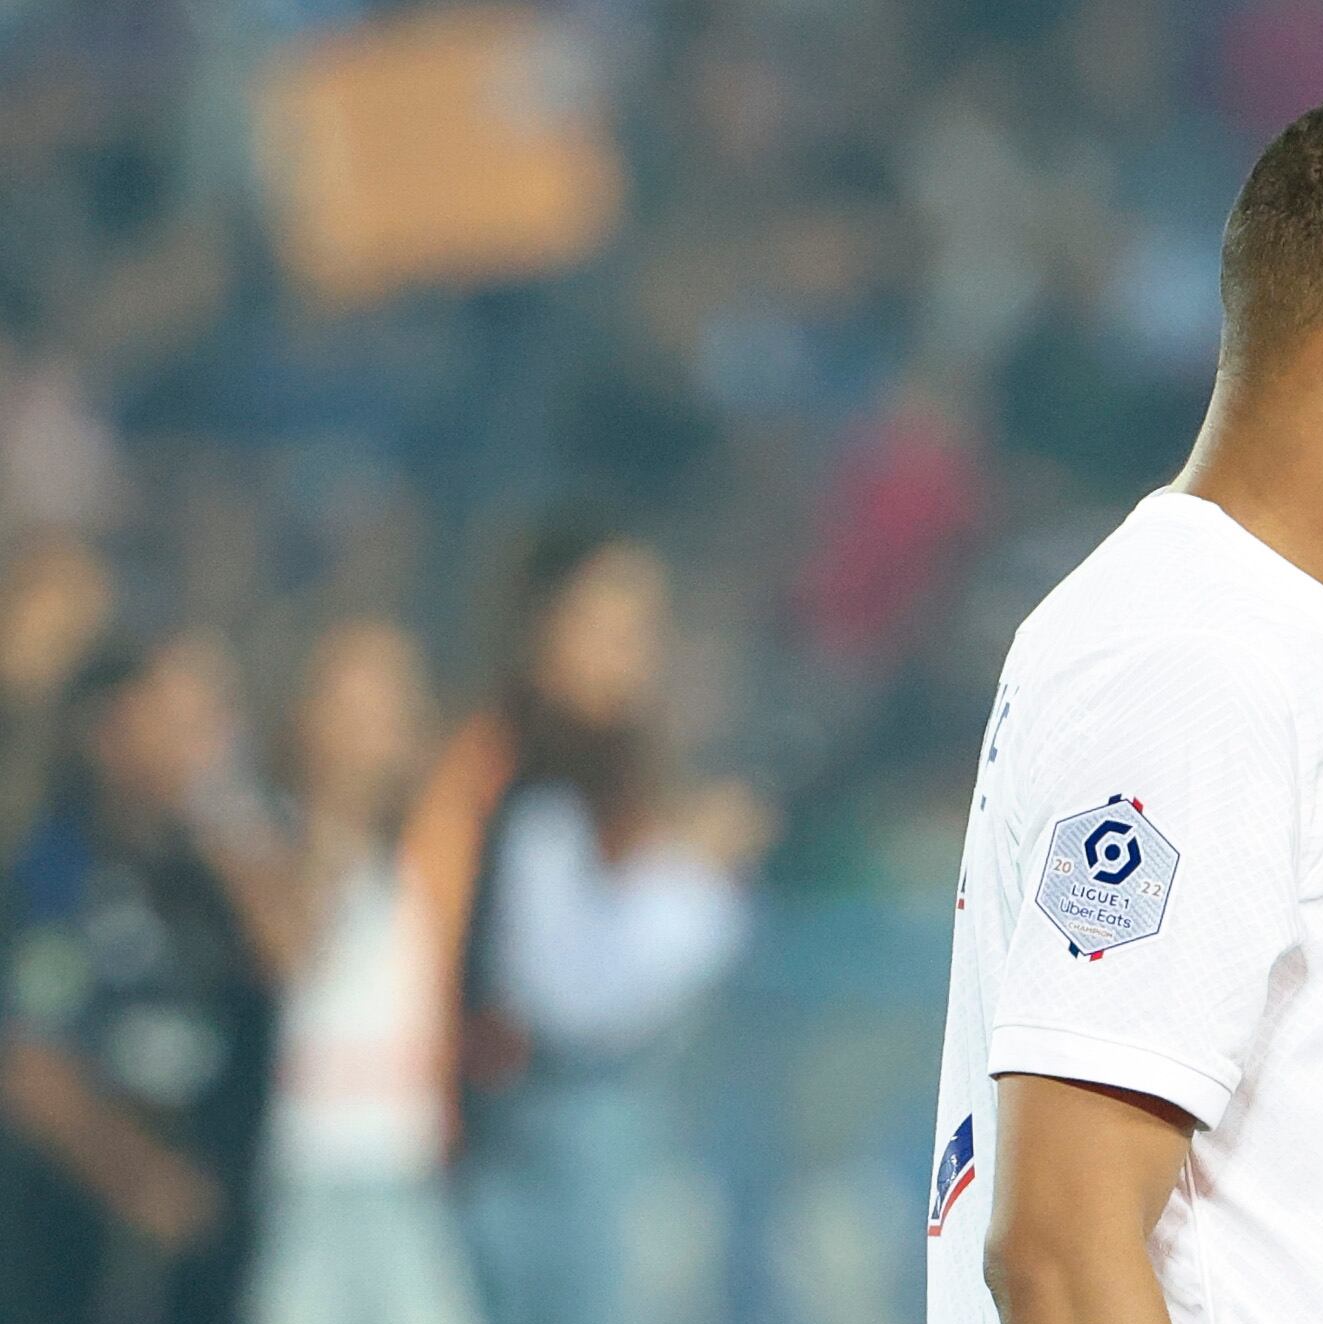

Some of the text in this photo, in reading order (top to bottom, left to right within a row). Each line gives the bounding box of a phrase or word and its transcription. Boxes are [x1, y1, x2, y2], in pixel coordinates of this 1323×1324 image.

[1071, 884, 1130, 910] LIGUE 1
[1059, 899, 1132, 929] Uber Eats
